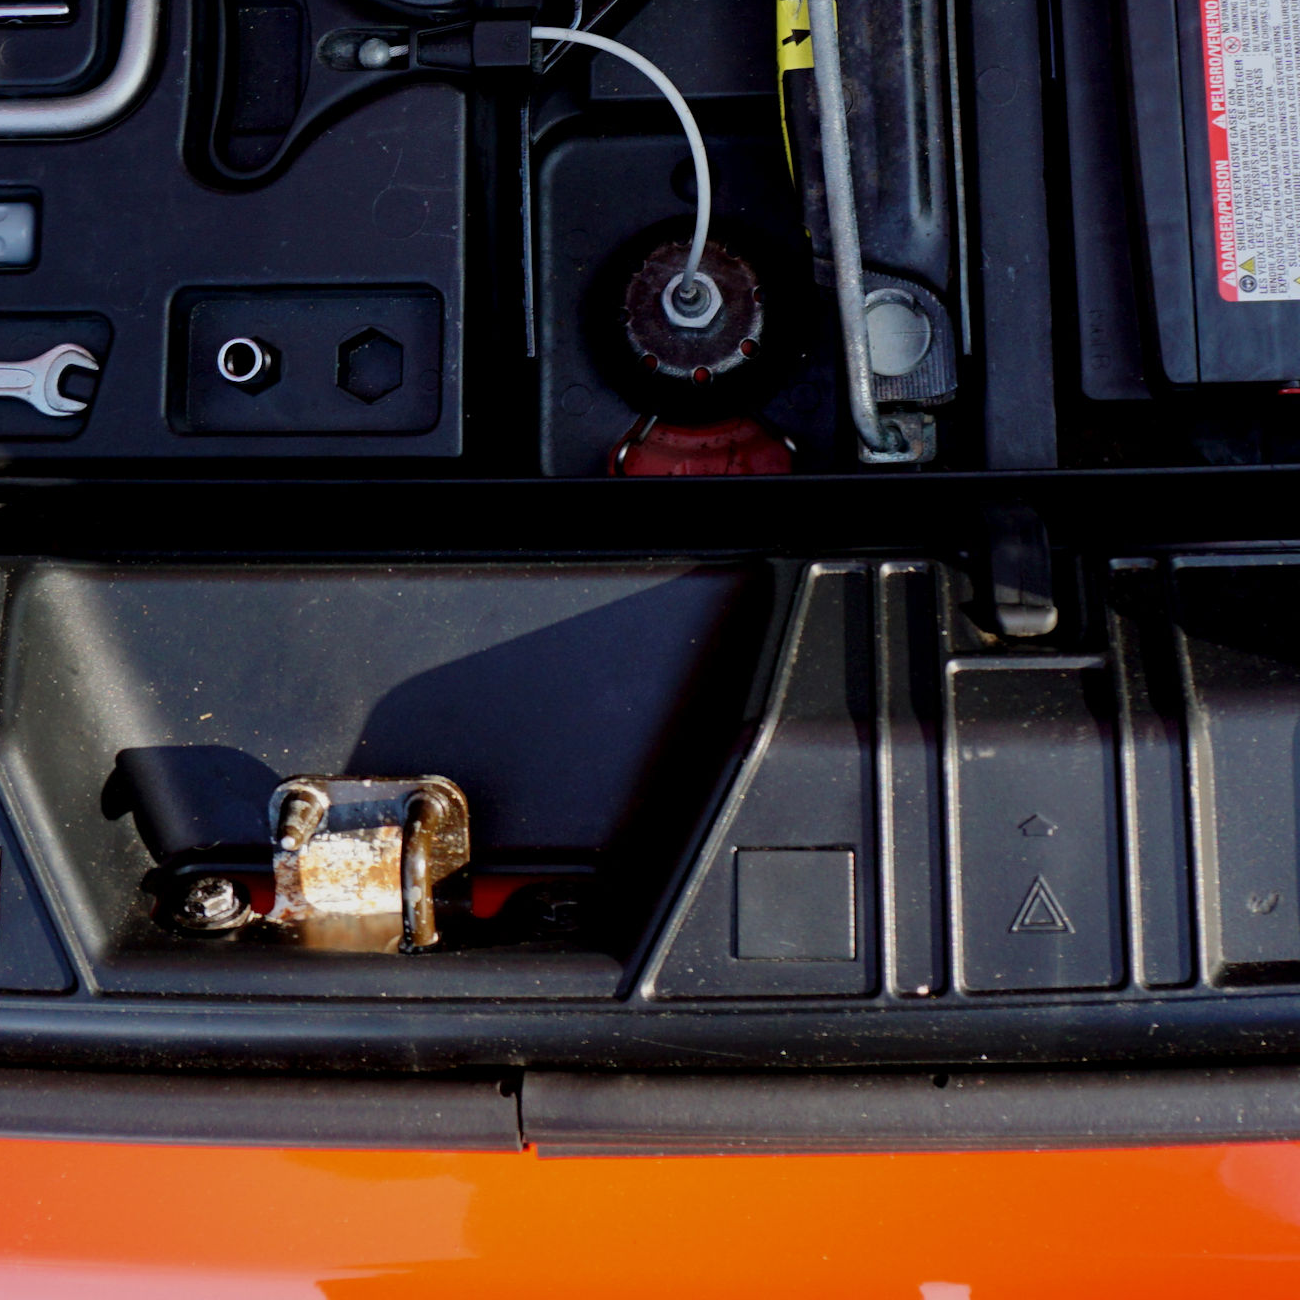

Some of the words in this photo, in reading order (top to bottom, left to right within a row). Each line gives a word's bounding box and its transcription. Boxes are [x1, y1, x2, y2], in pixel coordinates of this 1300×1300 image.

[1222, 22, 1230, 34] NO
[1231, 1, 1240, 33] SMOKING
[1204, 0, 1225, 112] PELIGRO/VENENO
[1242, 38, 1251, 53] PAS
[1261, 41, 1270, 52] NO
[1284, 42, 1293, 58] DES
[1275, 55, 1285, 85] SEVERE
[1285, 60, 1294, 72] OU
[1254, 67, 1265, 98] GASES
[1277, 87, 1286, 99] OR
[1227, 88, 1237, 107] CAN
[1246, 83, 1256, 118] BLESSER
[1256, 100, 1266, 118] LOS
[1288, 103, 1297, 113] LA
[1228, 109, 1239, 139] GASES
[1237, 110, 1247, 121] SE
[1278, 100, 1289, 147] BLINDNESS
[1248, 120, 1259, 157] PEUVENT
[1288, 115, 1299, 147] CAUSER
[1259, 149, 1269, 167] LOS
[1268, 133, 1278, 162] DAÑOS
[1291, 149, 1300, 170] PEUT
[1230, 141, 1242, 190] EXPLOSIVE
[1242, 160, 1251, 171] OR
[1281, 149, 1291, 176] CAUSE
[1251, 159, 1262, 208] EXPLOSIFS
[1261, 170, 1272, 211] PROTEJA
[1270, 164, 1281, 198] CAUSAR
[1283, 177, 1292, 196] CAN
[1234, 193, 1244, 216] EYES
[1243, 173, 1254, 220] BLINDNESS
[1284, 198, 1294, 221] ACID
[1215, 160, 1236, 271] DANGER/POISON
[1254, 210, 1264, 229] GAZ
[1273, 199, 1283, 233] PUEDEN
[1235, 218, 1246, 251] SHIELD
[1246, 222, 1256, 249] CAUSE
[1255, 232, 1265, 248] LES
[1286, 222, 1297, 267] SULFURIC
[1257, 250, 1267, 276] YEUX
[1275, 236, 1287, 293] EXPLOSIVOS
[1258, 278, 1268, 294] LES
[1267, 261, 1278, 294] RENDRE
